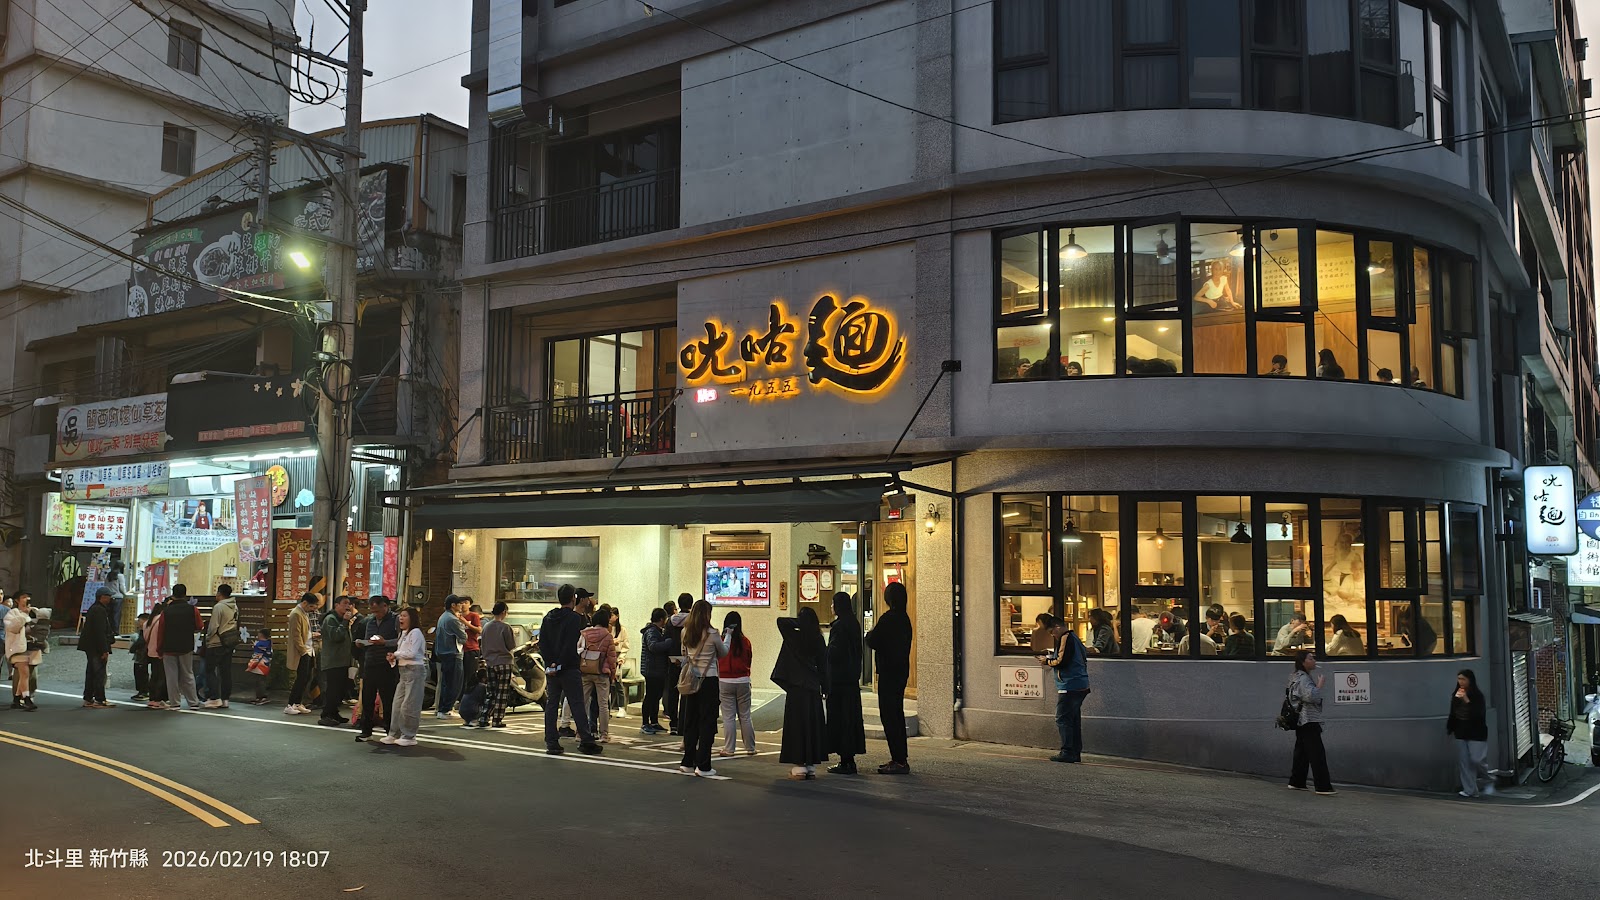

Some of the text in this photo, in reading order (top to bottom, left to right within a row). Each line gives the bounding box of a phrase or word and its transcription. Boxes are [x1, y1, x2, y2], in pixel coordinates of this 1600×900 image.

[731, 379, 796, 397] 一九五五
[280, 531, 311, 552] 吳記
[756, 571, 767, 579] 415
